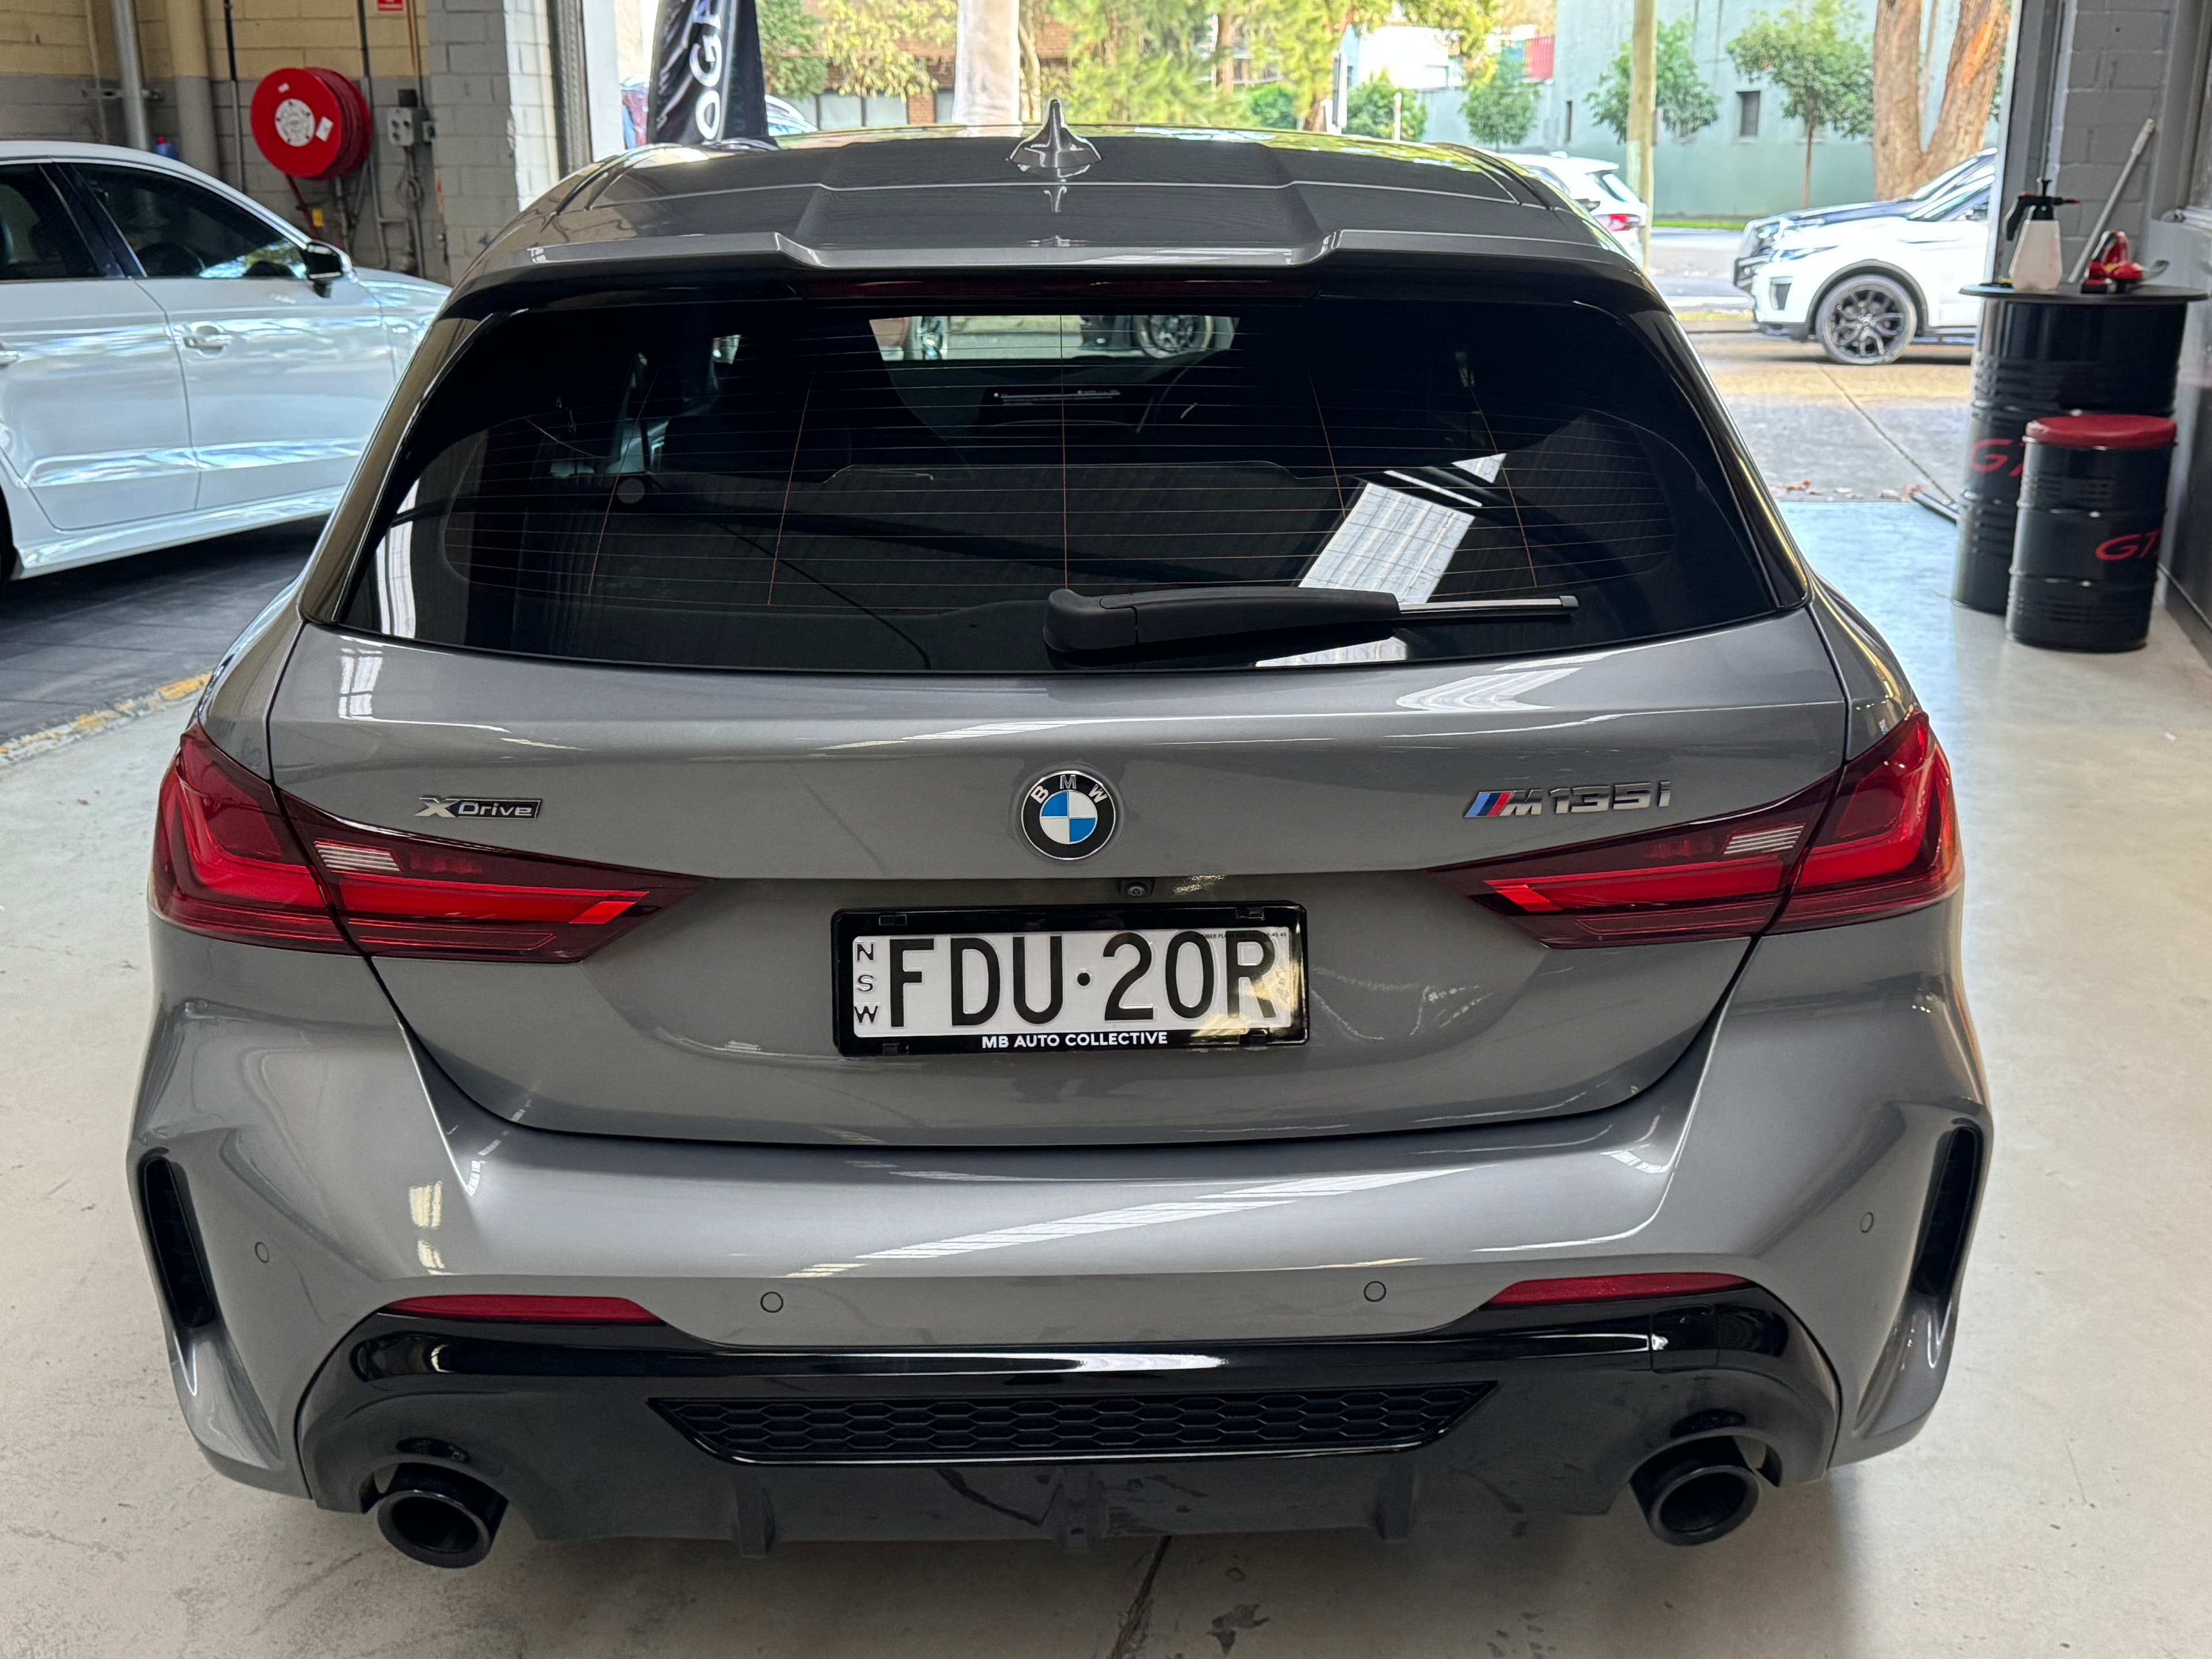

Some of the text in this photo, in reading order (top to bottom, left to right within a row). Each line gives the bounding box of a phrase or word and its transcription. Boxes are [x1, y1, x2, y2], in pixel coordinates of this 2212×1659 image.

[1030, 774, 1108, 804] BMW
[982, 1032, 1168, 1048] MB AUTO COLLECTIVE
